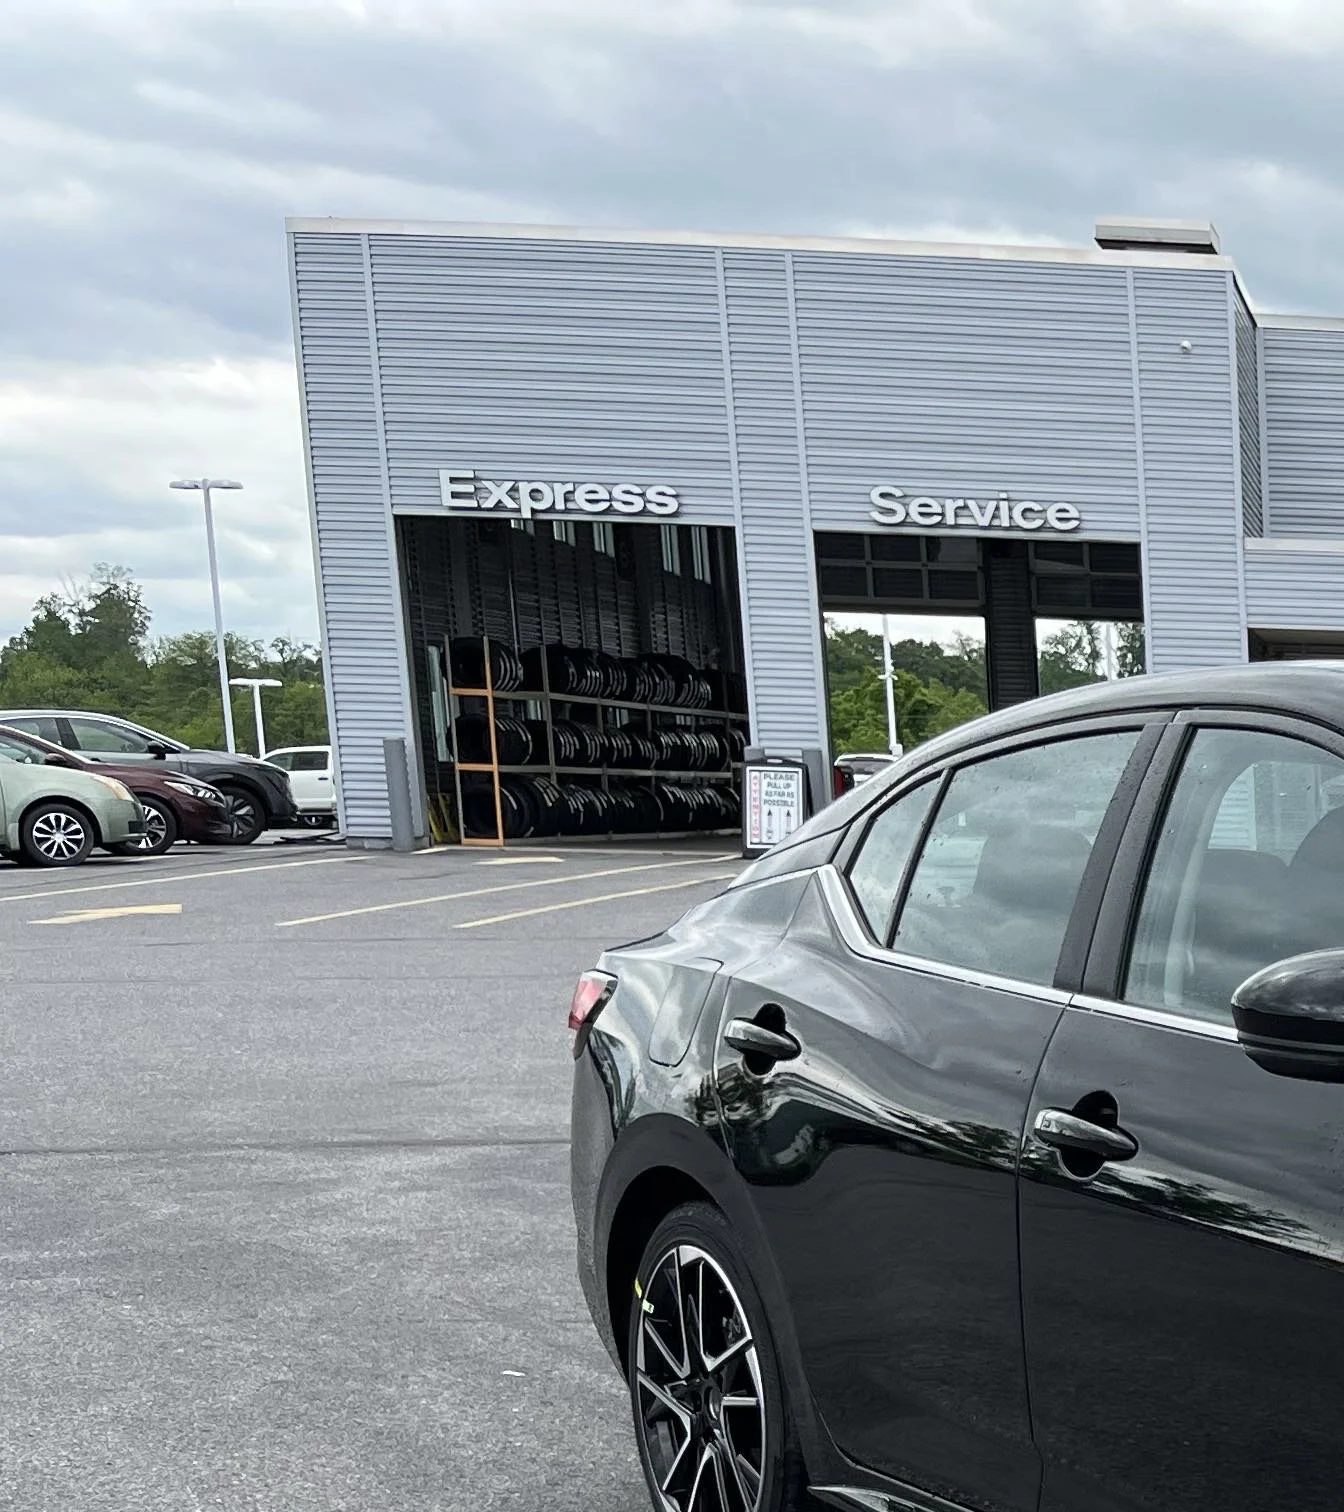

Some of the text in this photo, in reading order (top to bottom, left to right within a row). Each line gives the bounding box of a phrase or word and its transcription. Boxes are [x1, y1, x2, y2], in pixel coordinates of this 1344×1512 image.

[438, 469, 1081, 532] Express Service
[763, 773, 796, 781] PLEASE
